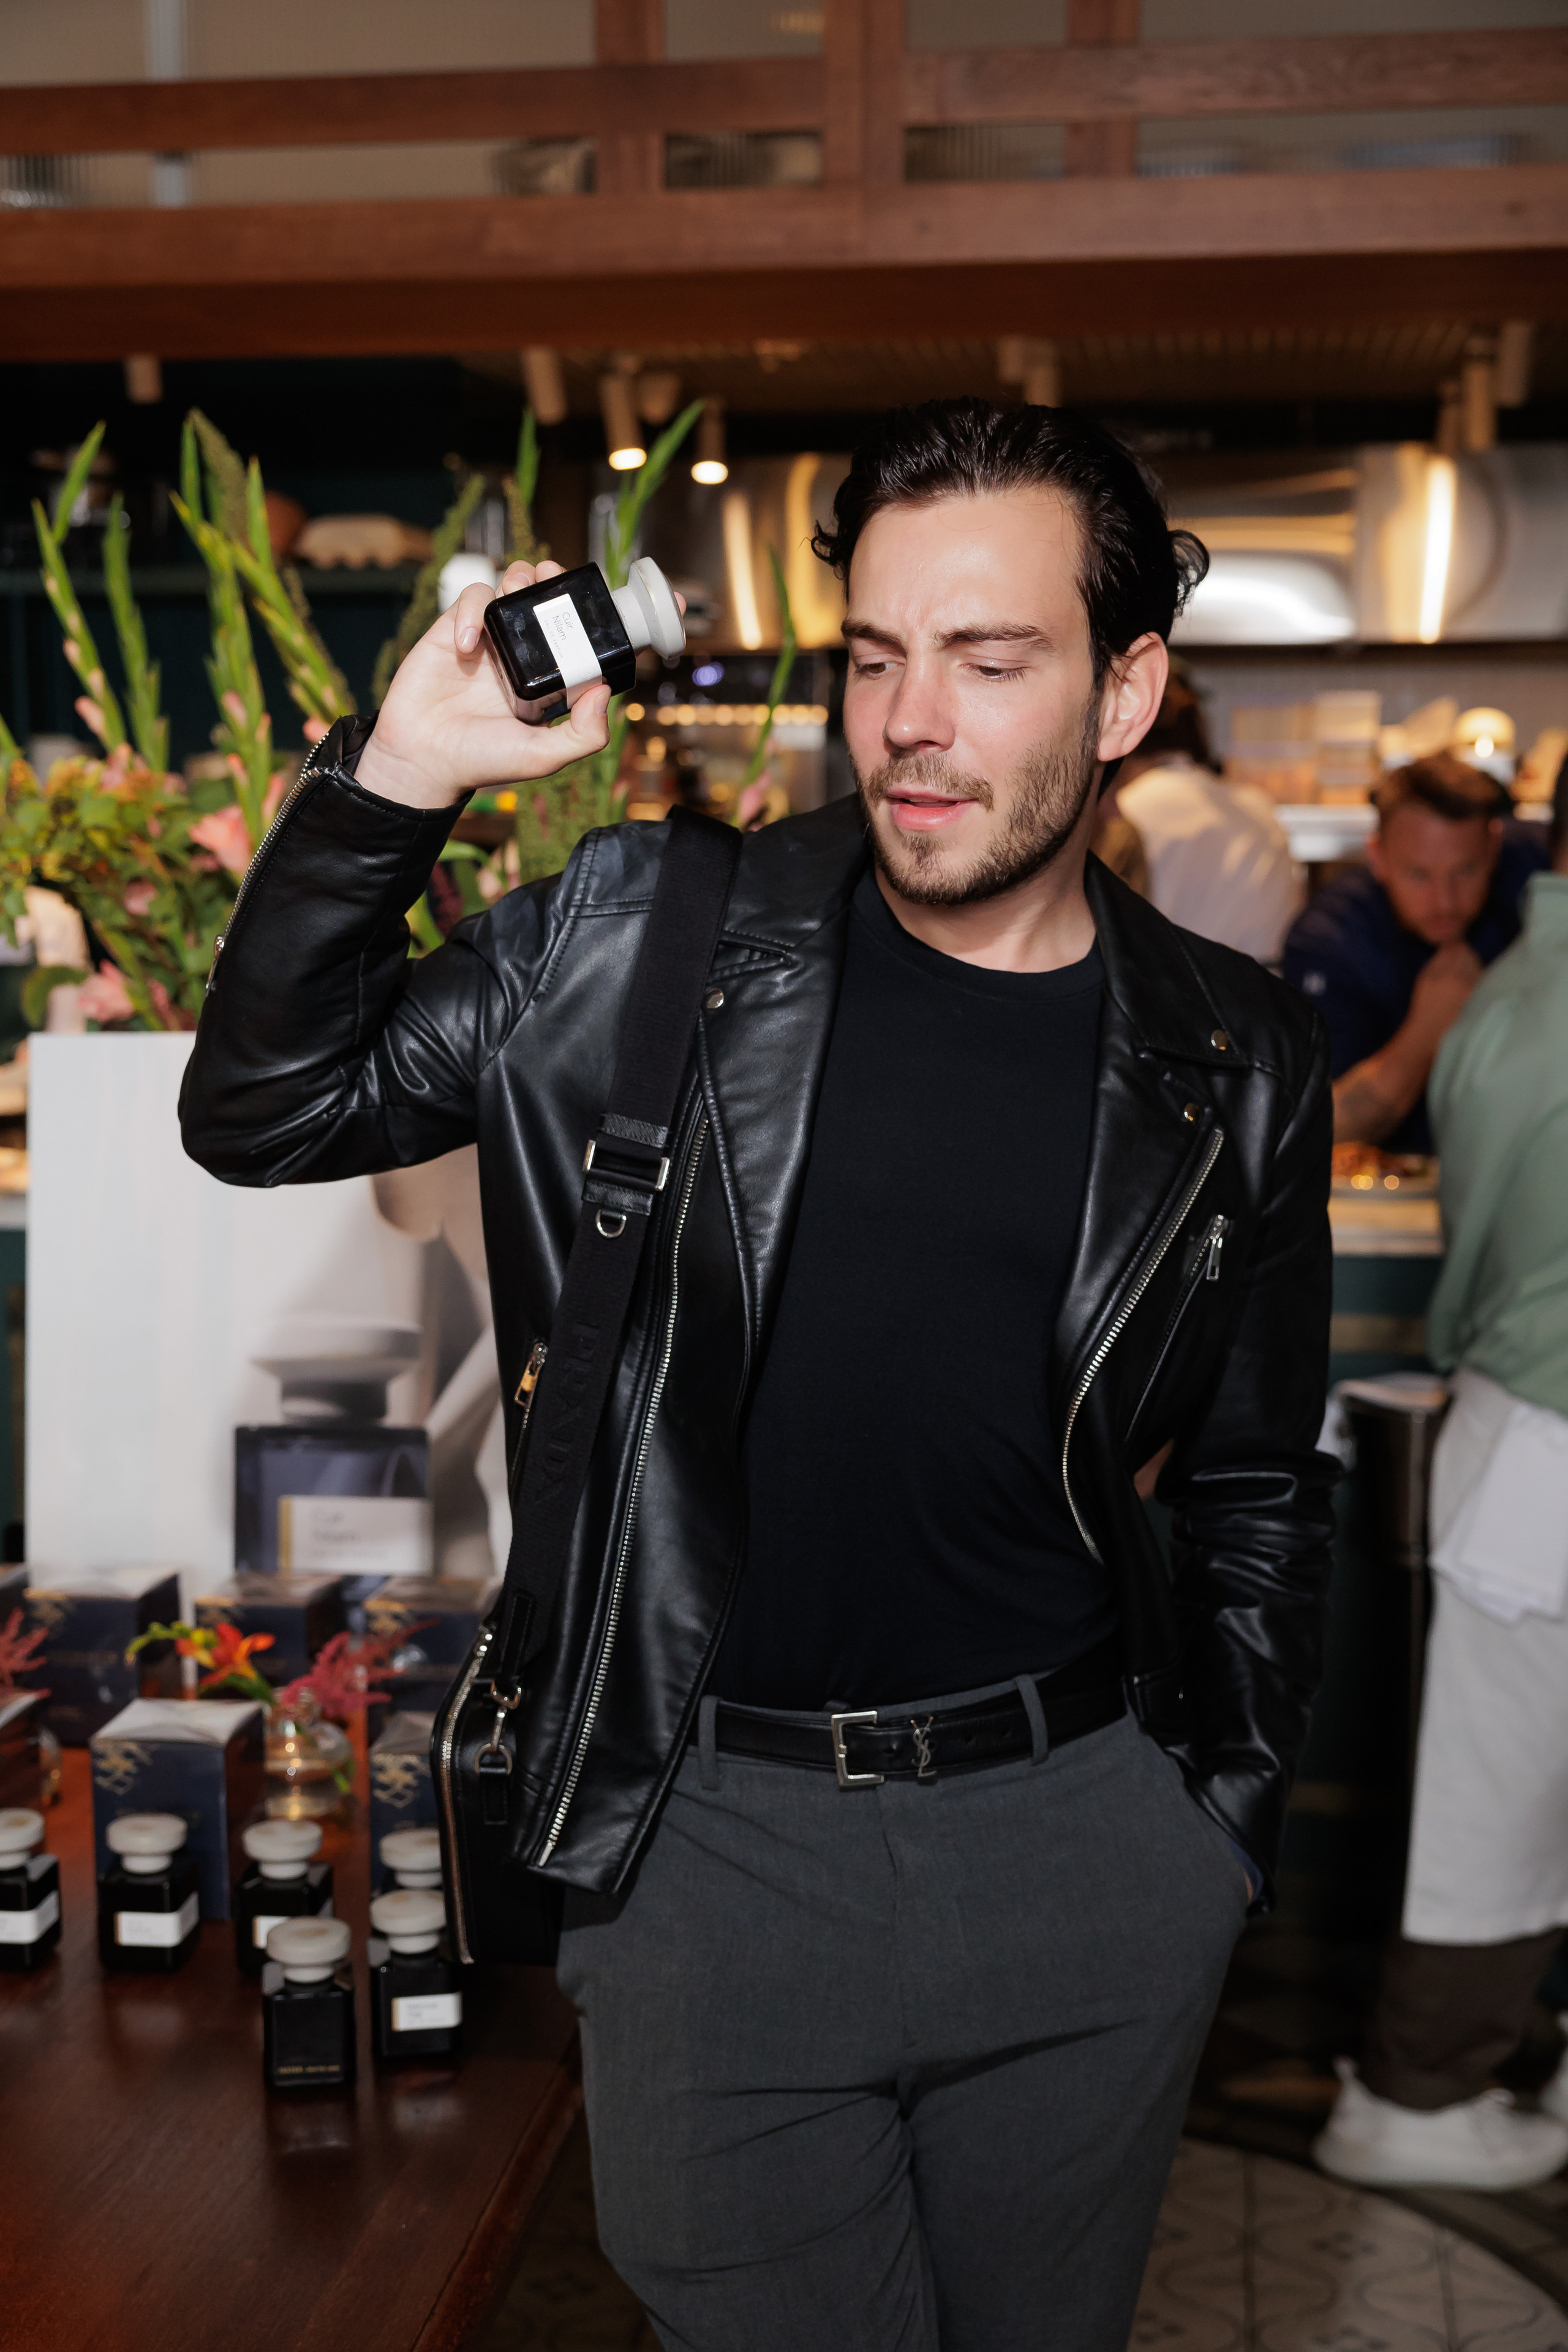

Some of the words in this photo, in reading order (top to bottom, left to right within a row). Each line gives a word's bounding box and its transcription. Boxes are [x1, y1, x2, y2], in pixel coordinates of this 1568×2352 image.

[552, 616, 567, 641] Nilam
[562, 612, 573, 628] Cuir
[553, 639, 564, 658] PARFUM
